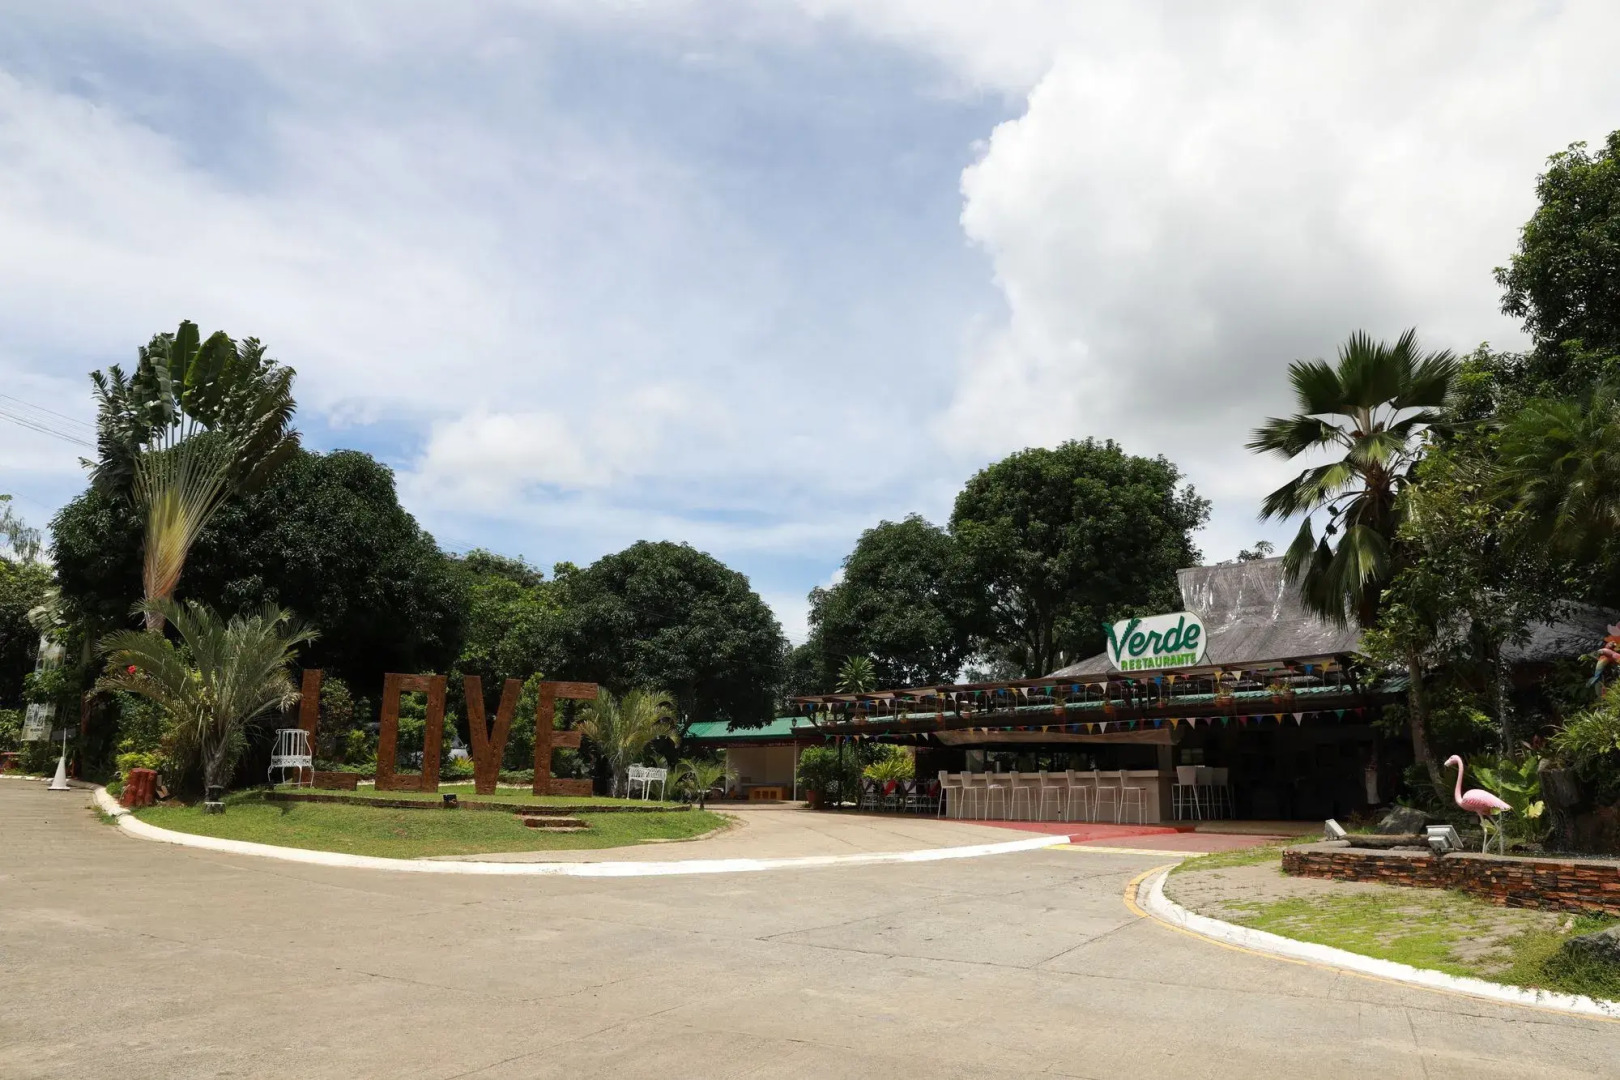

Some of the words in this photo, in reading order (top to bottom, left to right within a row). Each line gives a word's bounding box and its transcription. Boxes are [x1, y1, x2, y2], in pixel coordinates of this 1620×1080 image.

[1102, 615, 1200, 662] Verde
[1121, 652, 1197, 671] RESTAURANTE
[293, 669, 598, 796] LOVE
